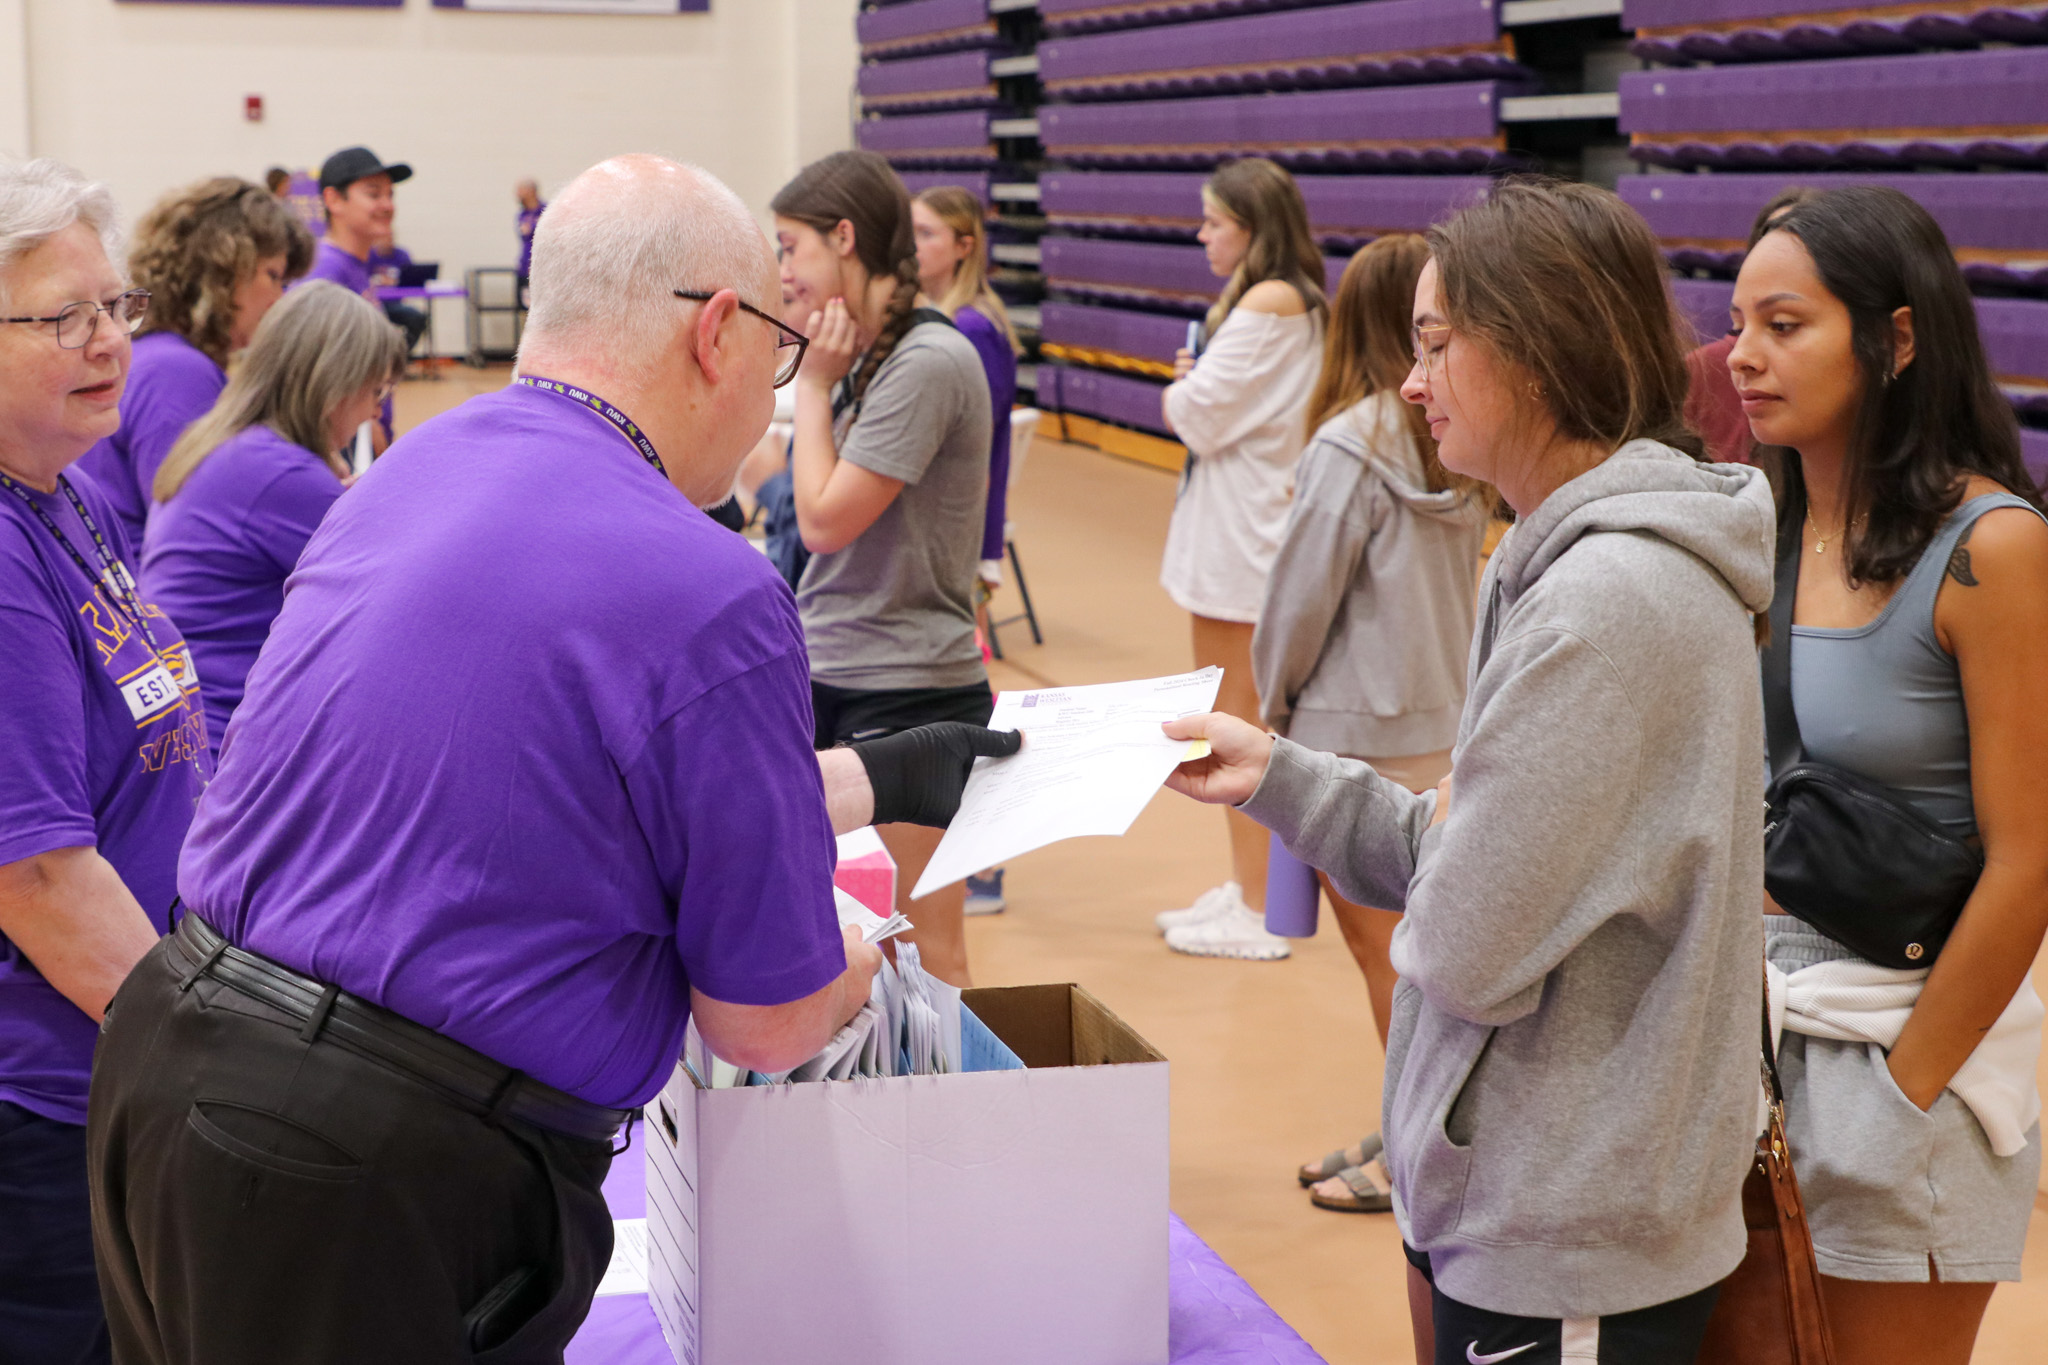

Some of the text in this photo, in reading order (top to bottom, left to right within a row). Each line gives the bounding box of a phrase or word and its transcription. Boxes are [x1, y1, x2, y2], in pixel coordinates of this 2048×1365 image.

[537, 380, 552, 390] KWU
[568, 388, 588, 401] KWU
[606, 408, 626, 425] KWU
[638, 438, 655, 458] KWU
[136, 675, 174, 708] EST.
